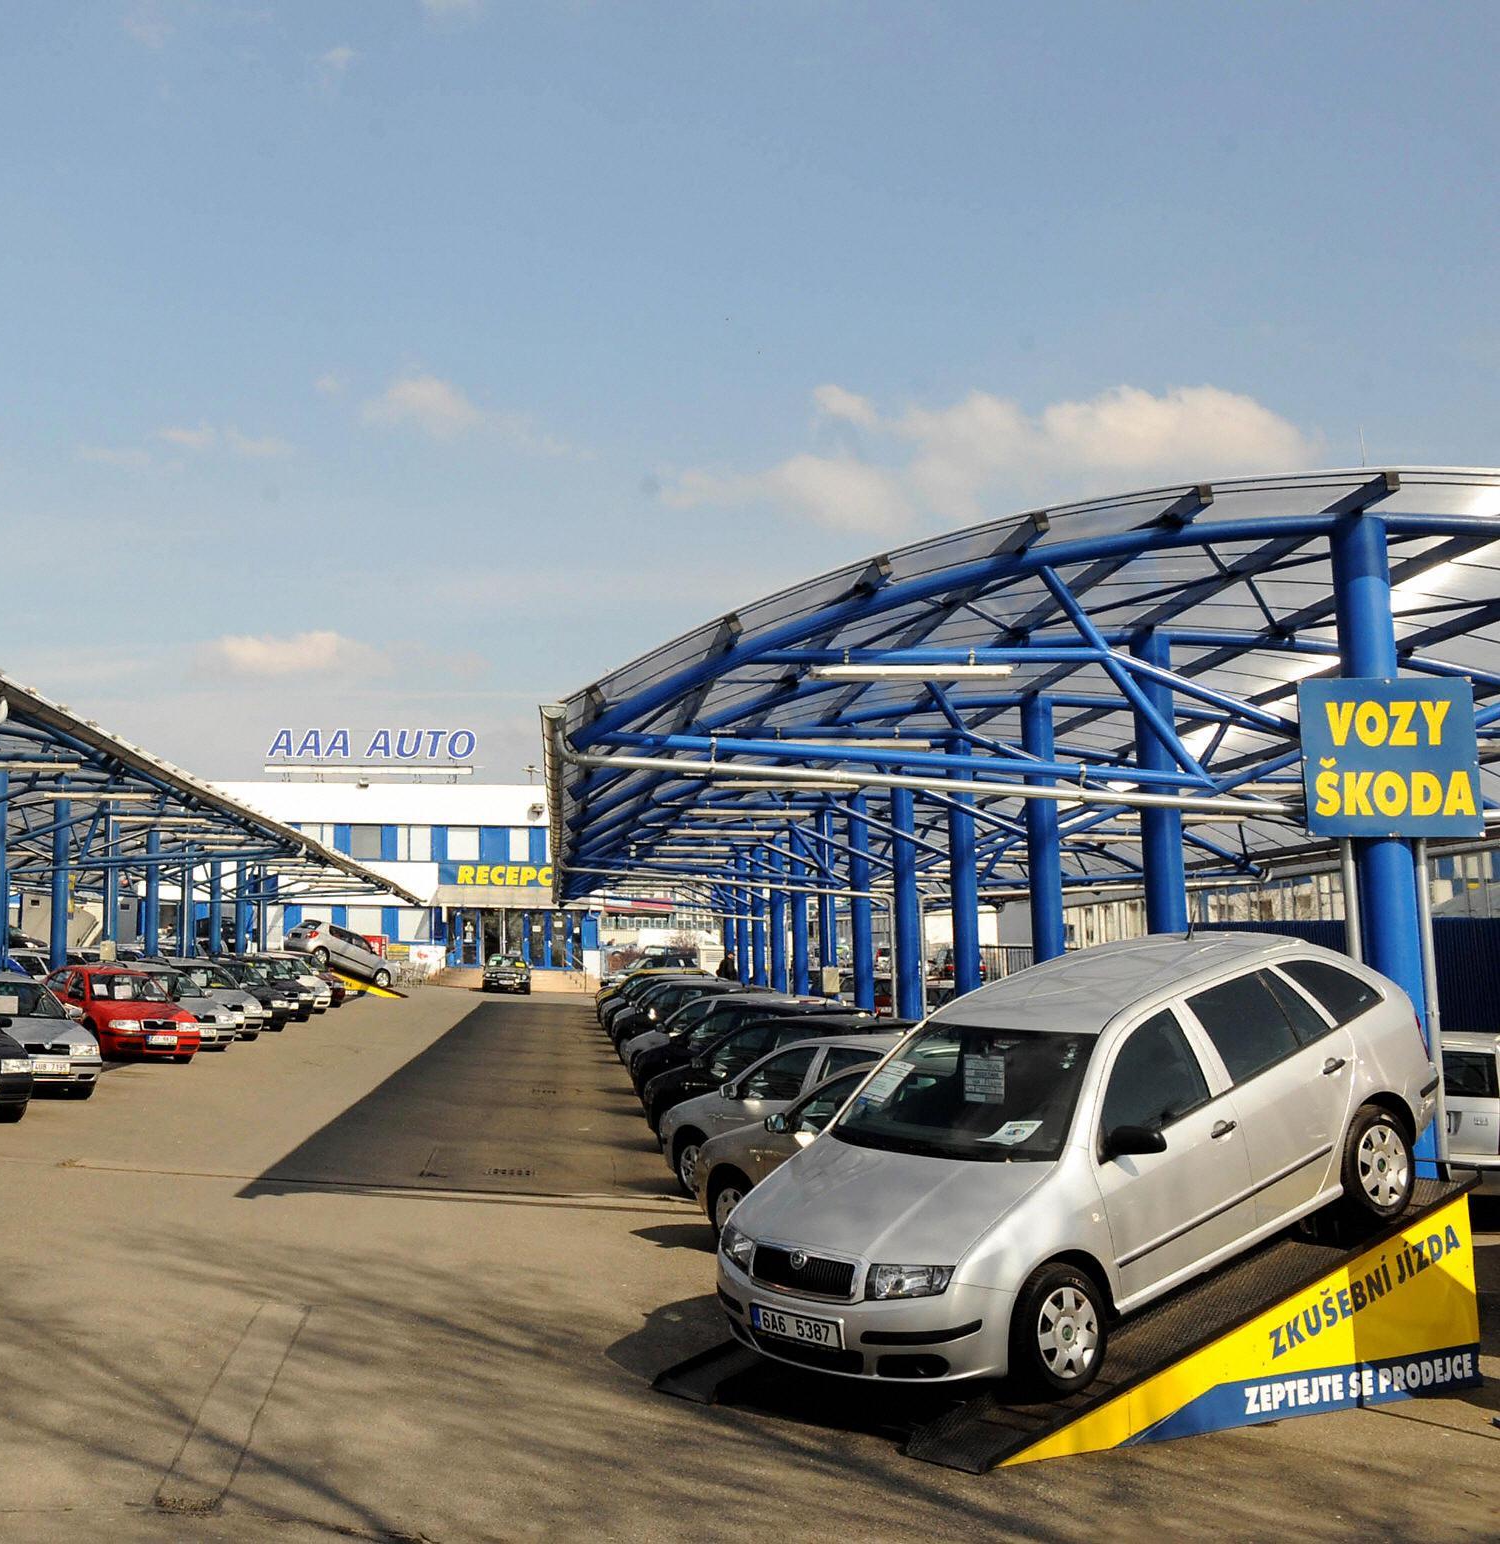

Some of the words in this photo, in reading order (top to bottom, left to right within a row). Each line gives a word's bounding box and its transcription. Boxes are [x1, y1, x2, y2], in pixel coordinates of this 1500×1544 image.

[266, 728, 351, 758] AAA
[364, 728, 476, 759] AUTO
[1325, 700, 1452, 747] VOZY
[1315, 757, 1477, 817] ŠKODA
[1269, 1256, 1393, 1360] ZKUŠEBNÍ
[1396, 1224, 1460, 1284] JÍZDA
[762, 1312, 786, 1333] 6A6
[796, 1319, 830, 1342] 5387
[1244, 1374, 1344, 1415] ZEPTEJTE
[1349, 1370, 1374, 1398] SE
[1379, 1353, 1474, 1394] PRODEJCE
